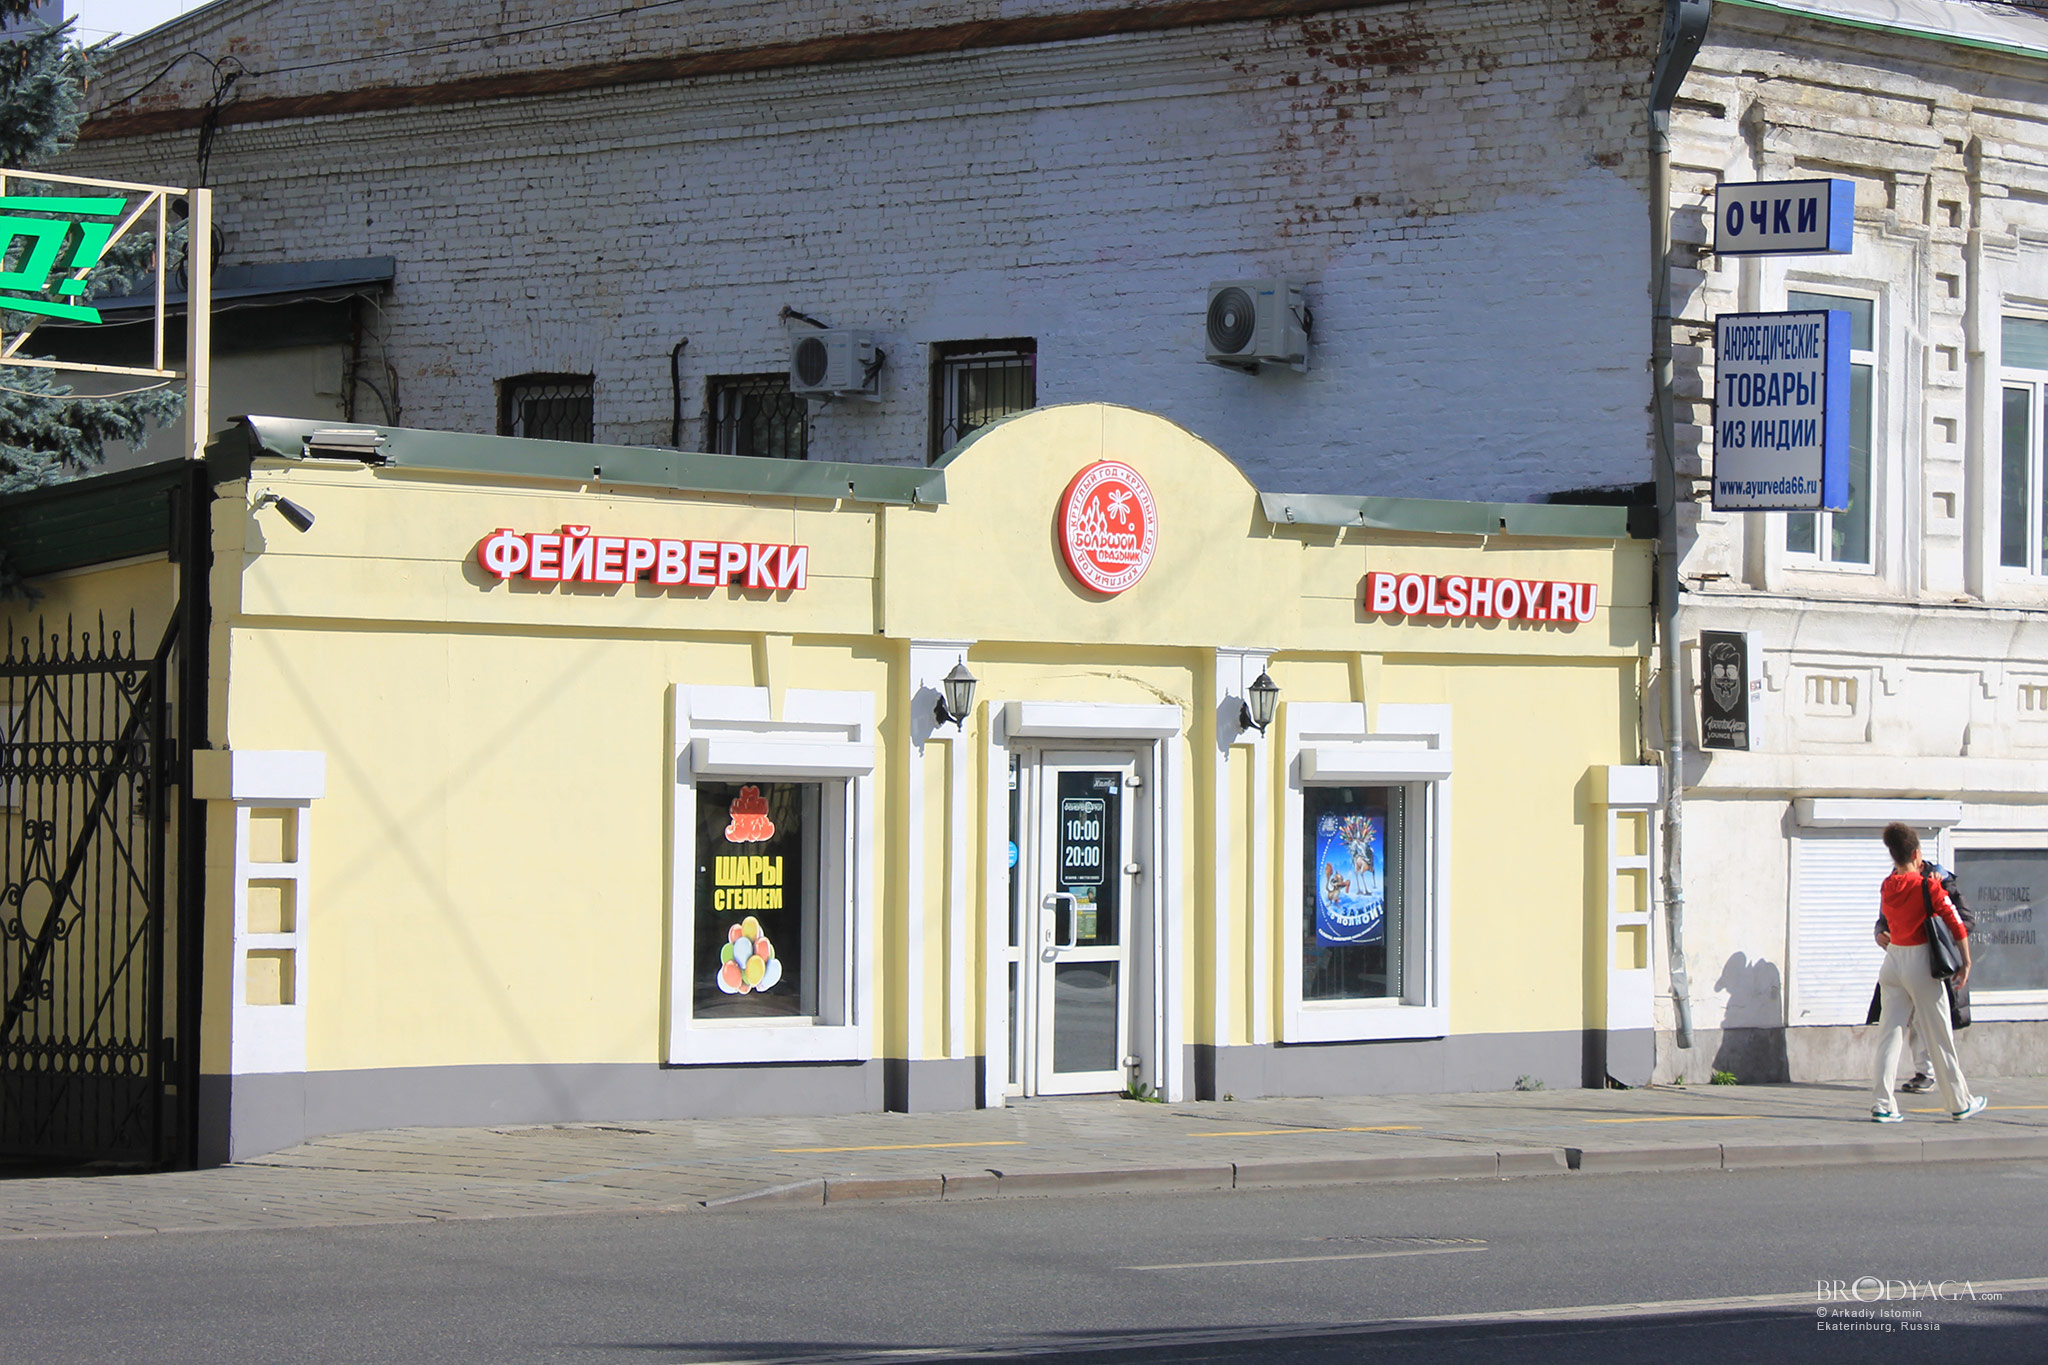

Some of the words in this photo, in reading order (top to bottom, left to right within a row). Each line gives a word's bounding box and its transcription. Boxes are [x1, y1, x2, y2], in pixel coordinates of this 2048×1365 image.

[1725, 197, 1818, 237] ОЧКИ
[1723, 323, 1820, 365] АЮРВЕДИЧЕСКИЕ
[1724, 371, 1817, 408] ТОВАРЫ
[1721, 420, 1746, 449] ИЗ
[1751, 418, 1817, 451] ИНДИИ
[1071, 472, 1098, 528] КРУГЛЫЙ
[1099, 468, 1119, 479] ГОД
[1720, 475, 1817, 500] www.ayurveda66.ru
[480, 525, 808, 590] ФЕЙЕРВЕРКИ
[1098, 550, 1141, 563] ПРАЗДНИК
[1369, 572, 1597, 623] BOLSHOY.RU
[1066, 820, 1100, 841] 10:00
[714, 855, 783, 887] ШАРЫ
[1065, 846, 1100, 867] 20:00
[713, 888, 726, 911] С
[726, 887, 783, 911] ГЕЛИЕМ
